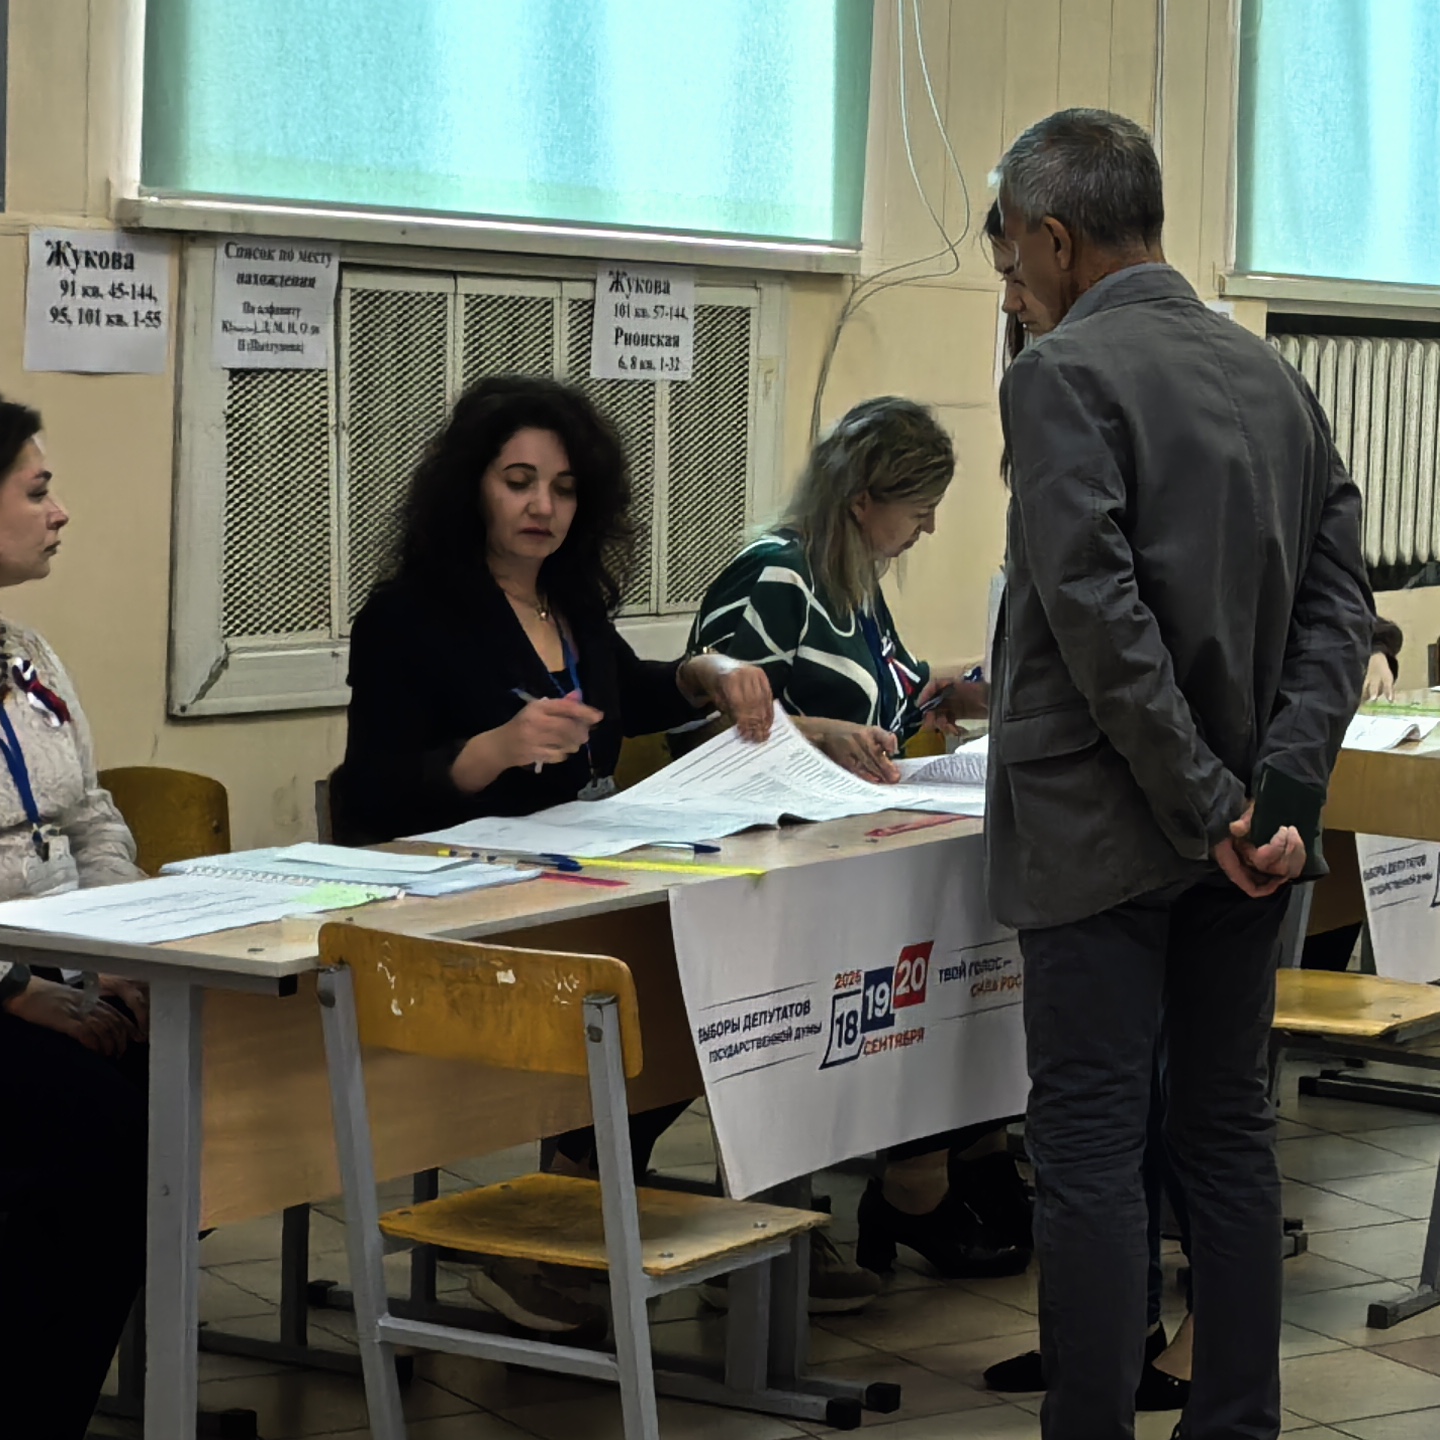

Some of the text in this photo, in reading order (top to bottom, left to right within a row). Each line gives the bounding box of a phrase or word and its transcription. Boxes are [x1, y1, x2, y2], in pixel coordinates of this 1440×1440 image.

[45, 239, 135, 275] Жукова
[224, 241, 276, 261] Список
[59, 279, 76, 297] 91
[608, 269, 671, 300] Жукова
[78, 307, 101, 326] 101
[614, 303, 630, 319] 101
[614, 326, 680, 348] Рионская
[895, 956, 926, 996] 20
[865, 981, 891, 1020] 19
[697, 999, 811, 1045] ВЫБОРЫ ДЕПУТАТОВ
[835, 1009, 859, 1049] 18
[863, 1026, 926, 1056] СЕНТЯБРЯ
